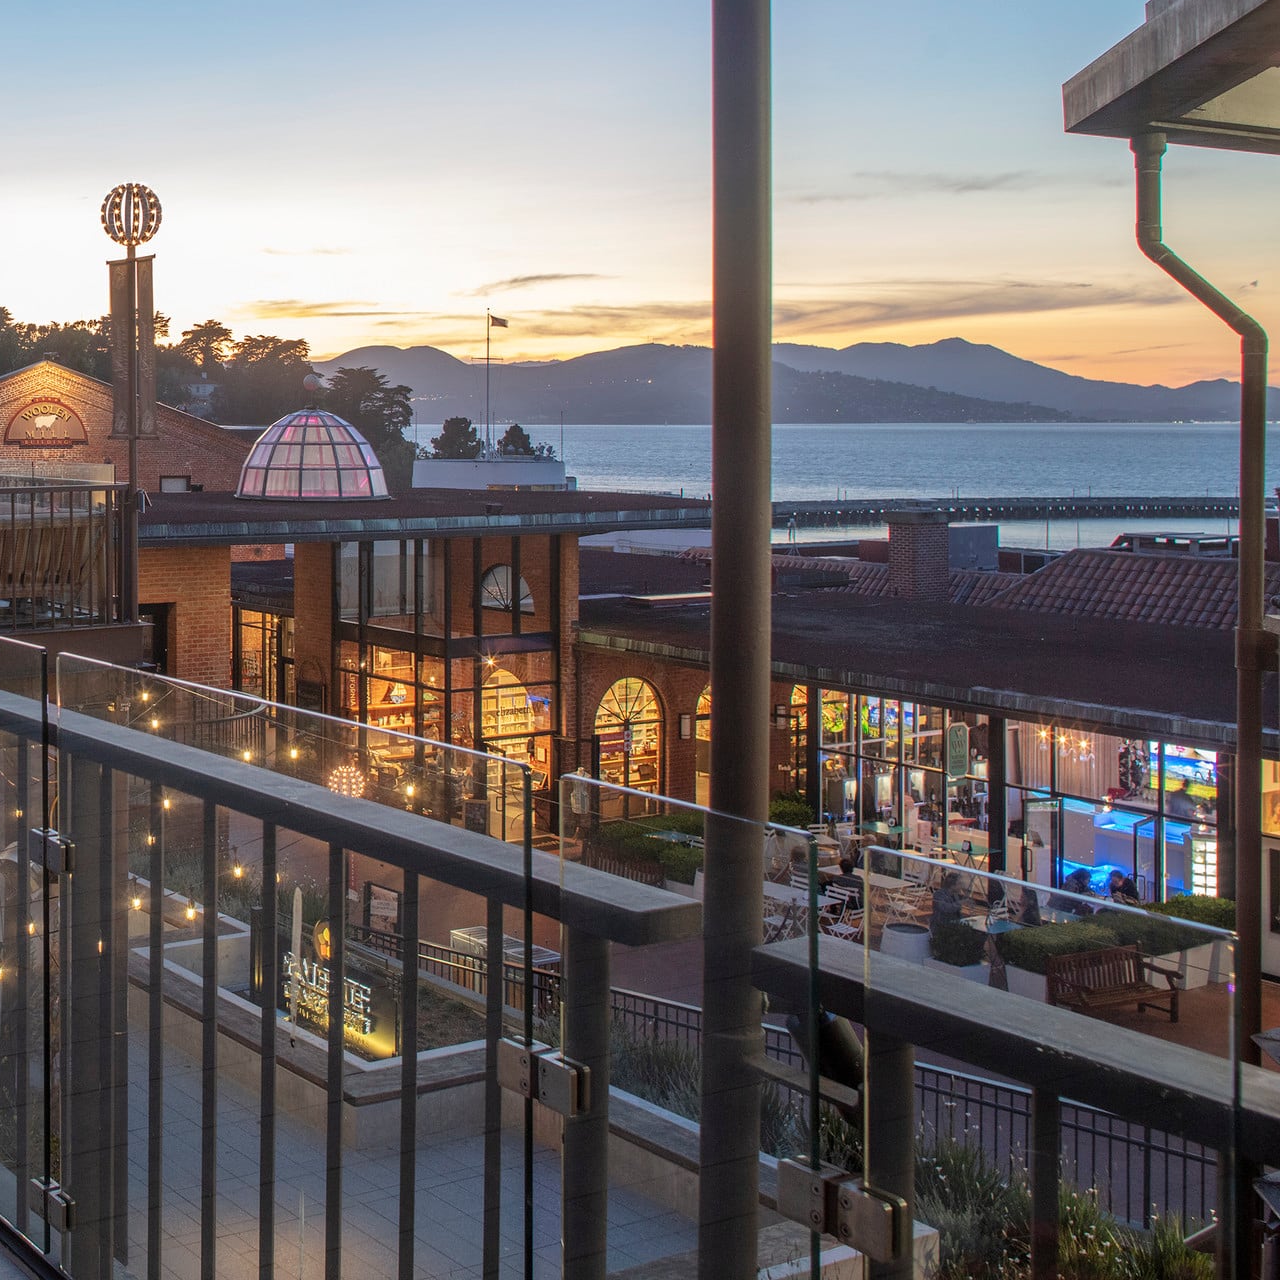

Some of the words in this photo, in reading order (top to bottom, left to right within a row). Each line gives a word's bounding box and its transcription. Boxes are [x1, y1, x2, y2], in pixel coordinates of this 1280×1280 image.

[21, 405, 71, 422] WOOLEN
[25, 430, 70, 440] MILL
[349, 662, 359, 707] CLIFORNIA
[496, 705, 531, 717] elizabeth
